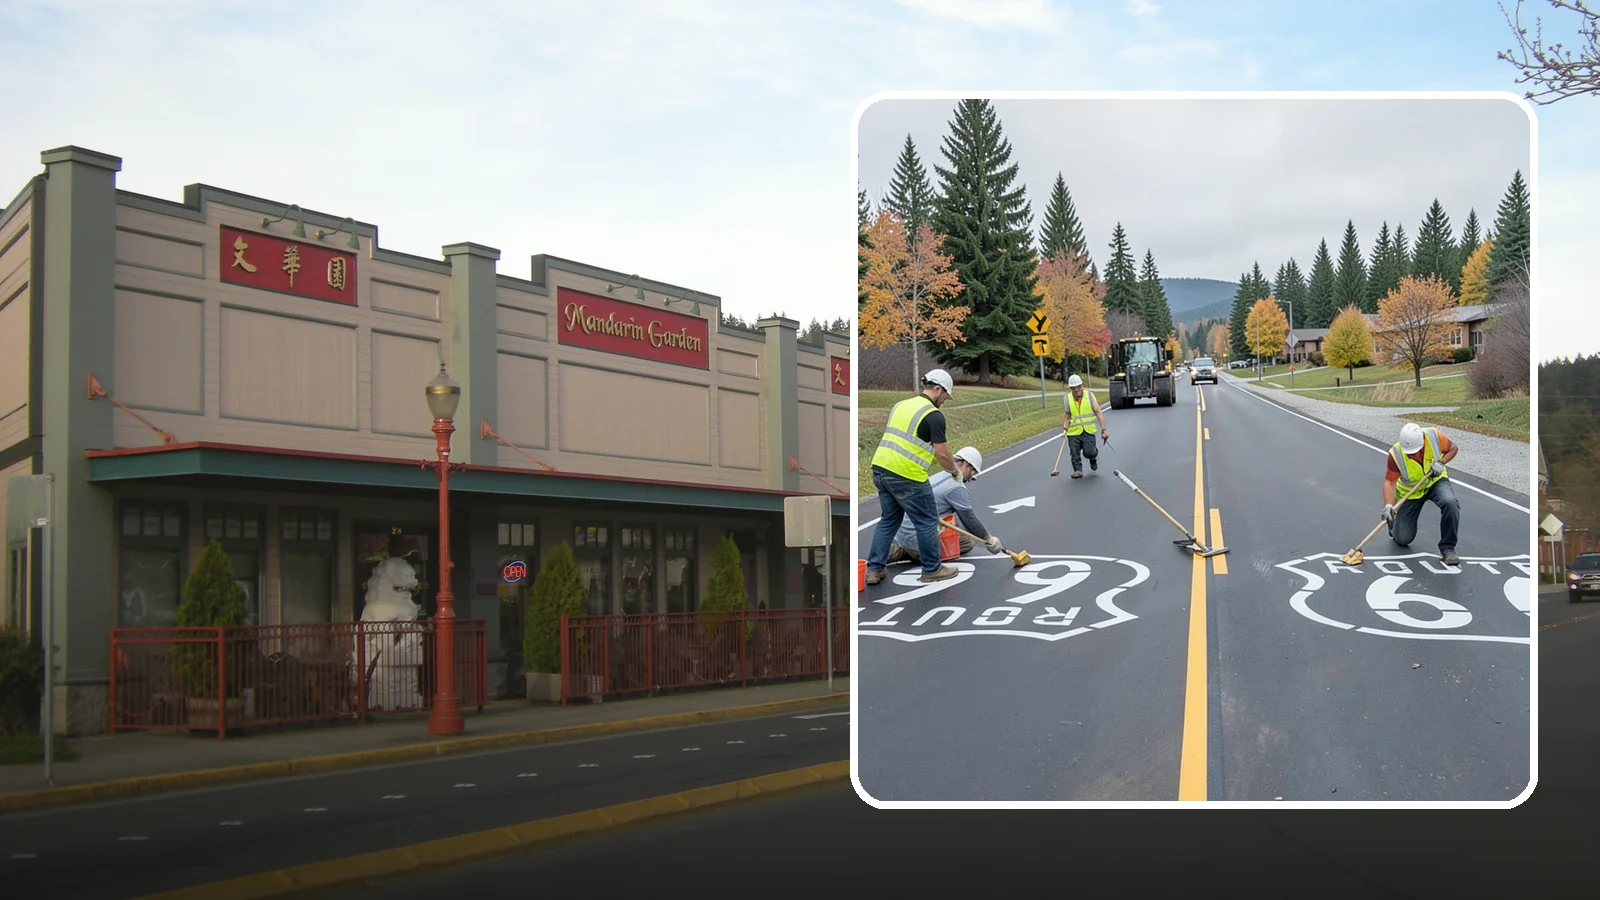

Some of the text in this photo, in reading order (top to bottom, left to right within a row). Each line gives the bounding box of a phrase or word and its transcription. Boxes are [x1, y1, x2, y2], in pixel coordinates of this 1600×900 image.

[231, 235, 346, 291] 文華園
[564, 302, 701, 352] Mandarin Garden
[503, 565, 527, 578] OPEN
[858, 606, 1082, 626] ROUT
[1365, 574, 1531, 629] 6
